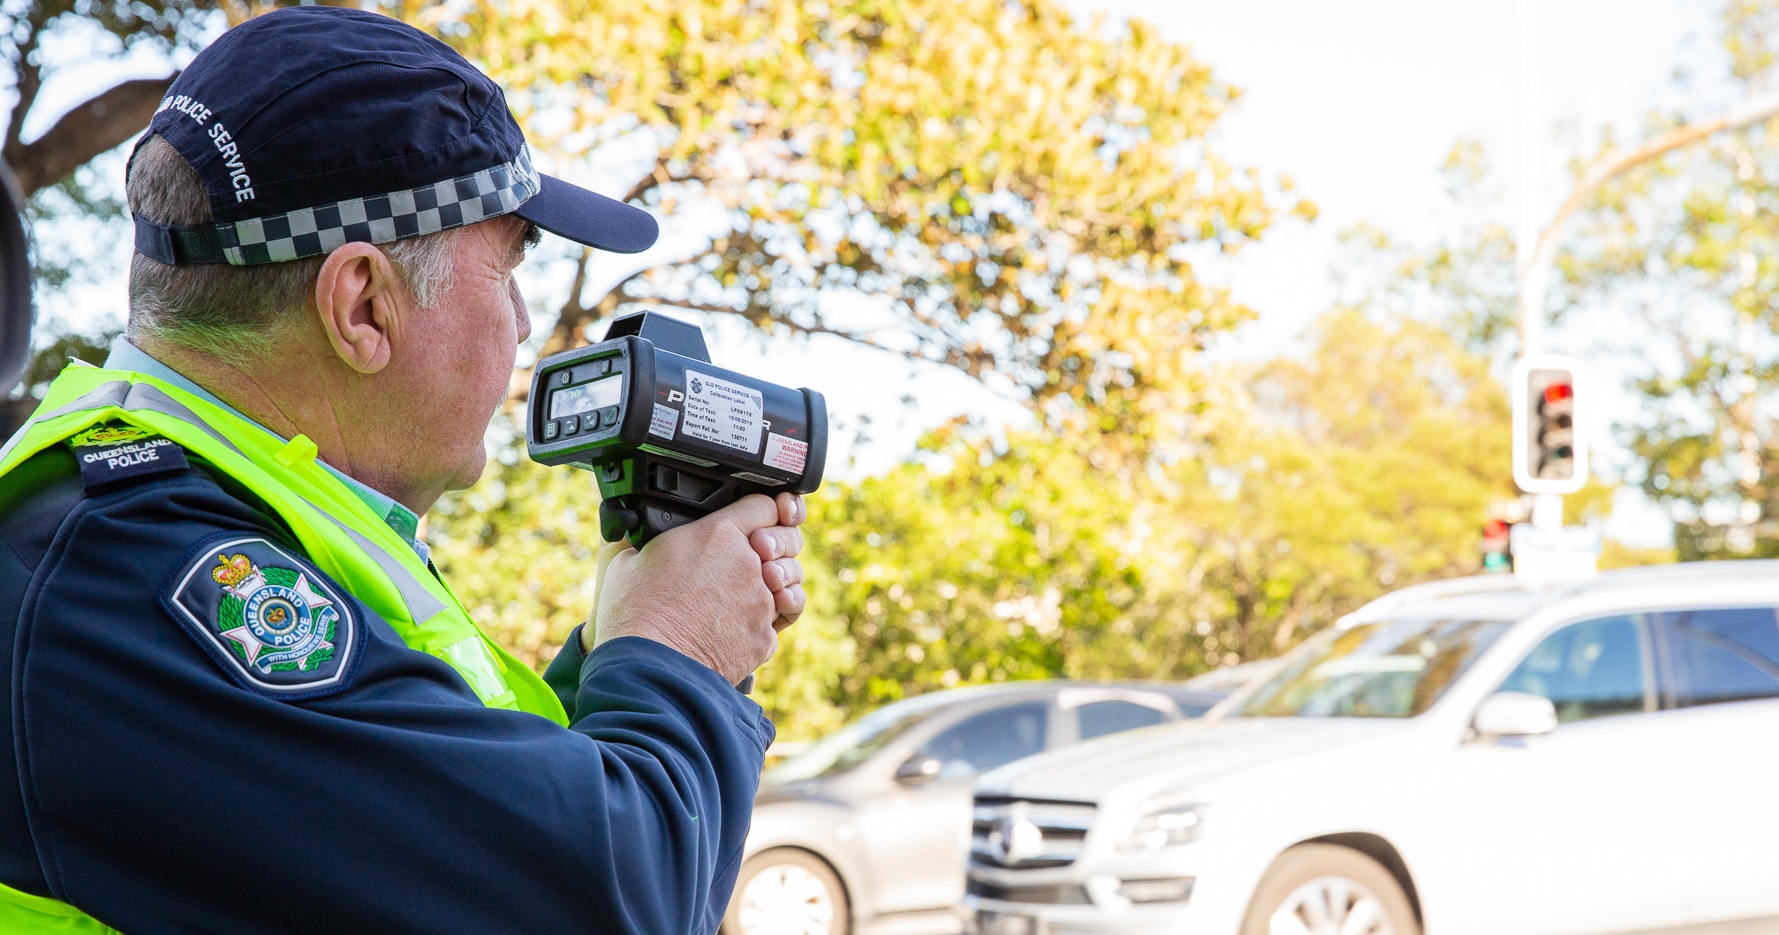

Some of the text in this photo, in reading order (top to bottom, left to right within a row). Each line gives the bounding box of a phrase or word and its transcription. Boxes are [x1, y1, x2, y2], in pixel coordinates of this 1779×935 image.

[170, 95, 255, 203] POLICE SERVICE
[710, 391, 732, 401] Calibration
[715, 384, 730, 392] POLICE
[732, 389, 750, 398] SERVICE
[685, 421, 700, 429] Report
[84, 439, 172, 463] QUEENSLAND
[108, 449, 159, 469] POLICE
[248, 588, 303, 637] QUEENSLAND
[275, 617, 309, 645] POLICE
[288, 643, 314, 659] HONOUR
[312, 634, 321, 645] WE
